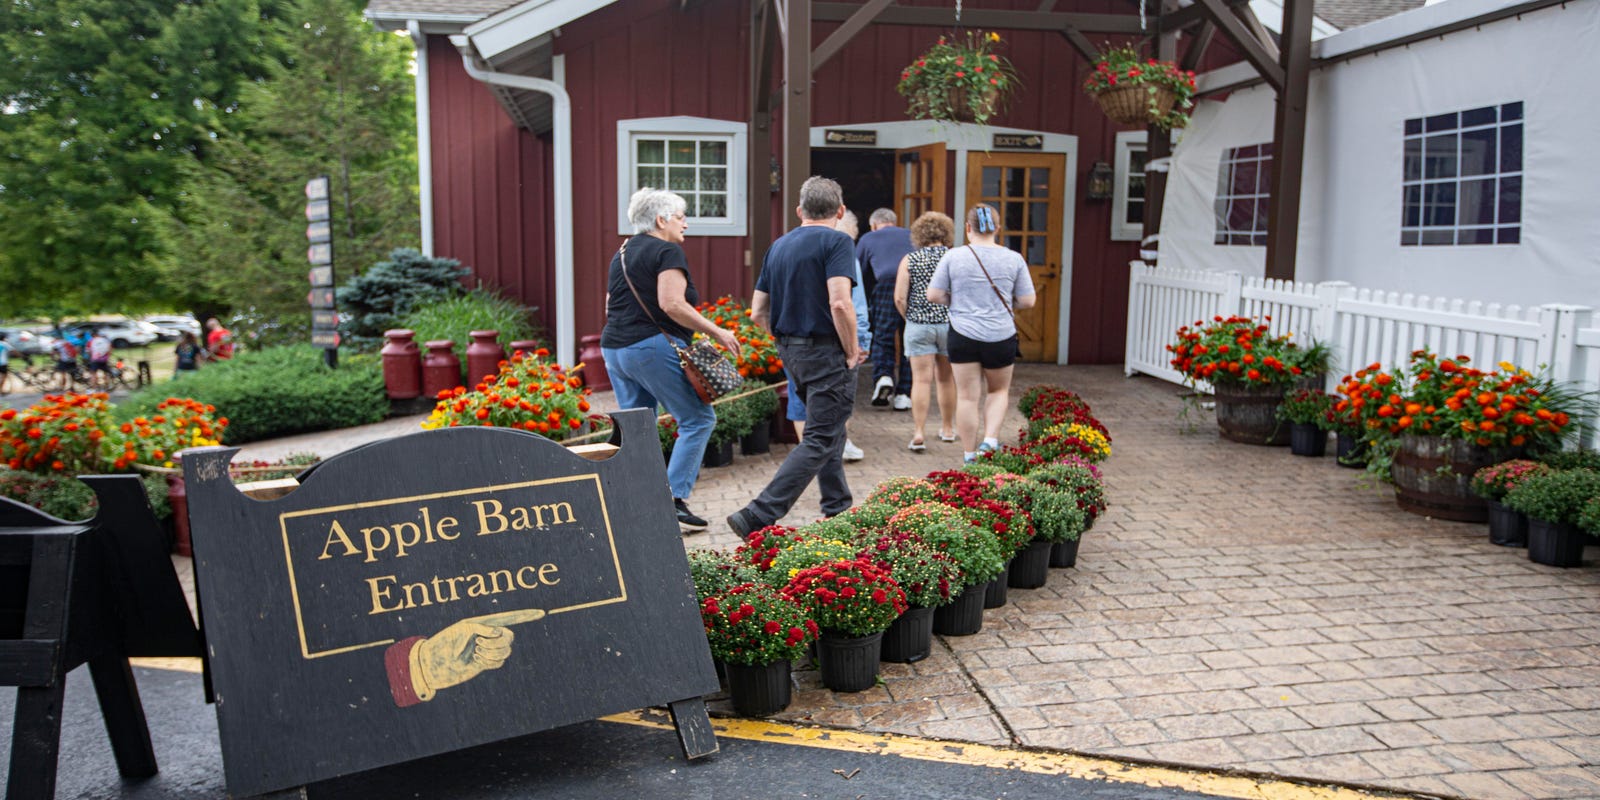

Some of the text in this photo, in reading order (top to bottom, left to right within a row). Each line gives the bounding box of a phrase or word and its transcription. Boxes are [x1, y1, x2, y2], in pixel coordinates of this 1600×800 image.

[995, 135, 1022, 146] EXIT
[317, 497, 578, 563] Apple Barn
[364, 561, 562, 615] Entrance
